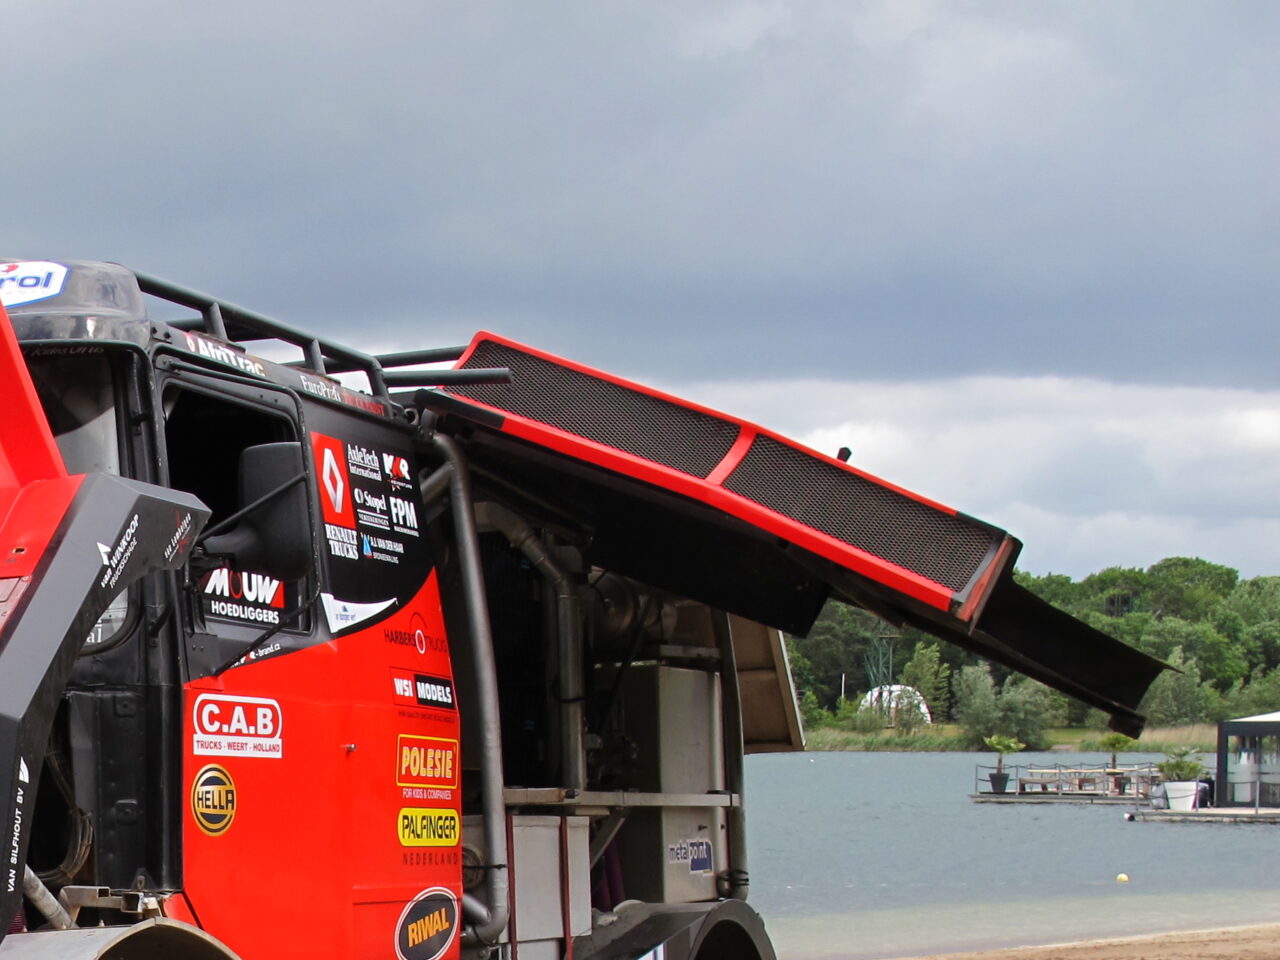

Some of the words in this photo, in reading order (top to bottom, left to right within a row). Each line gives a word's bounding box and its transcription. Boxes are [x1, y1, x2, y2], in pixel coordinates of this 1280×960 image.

[347, 443, 380, 468] AxleTech
[390, 496, 418, 529] FPM
[110, 513, 139, 569] WINKOOP
[324, 523, 358, 546] RENAULT
[329, 539, 359, 561] TRUCKS
[210, 599, 280, 624] HOEDLIGGERS
[393, 677, 414, 697] WSI
[416, 681, 452, 704] MODELS
[201, 703, 275, 736] C.A.B
[195, 740, 223, 751] TRUCKS
[227, 742, 248, 752] WEERT
[252, 743, 281, 754] HOLLAND
[401, 746, 453, 779] POLESIE
[16, 787, 25, 804] BV
[197, 789, 235, 811] HELLA
[9, 807, 23, 865] SILFHOUT
[402, 815, 457, 839] PALFINGER
[403, 852, 459, 867] NEDERLAND
[7, 868, 17, 892] VAN
[407, 907, 450, 948] RIWAL
